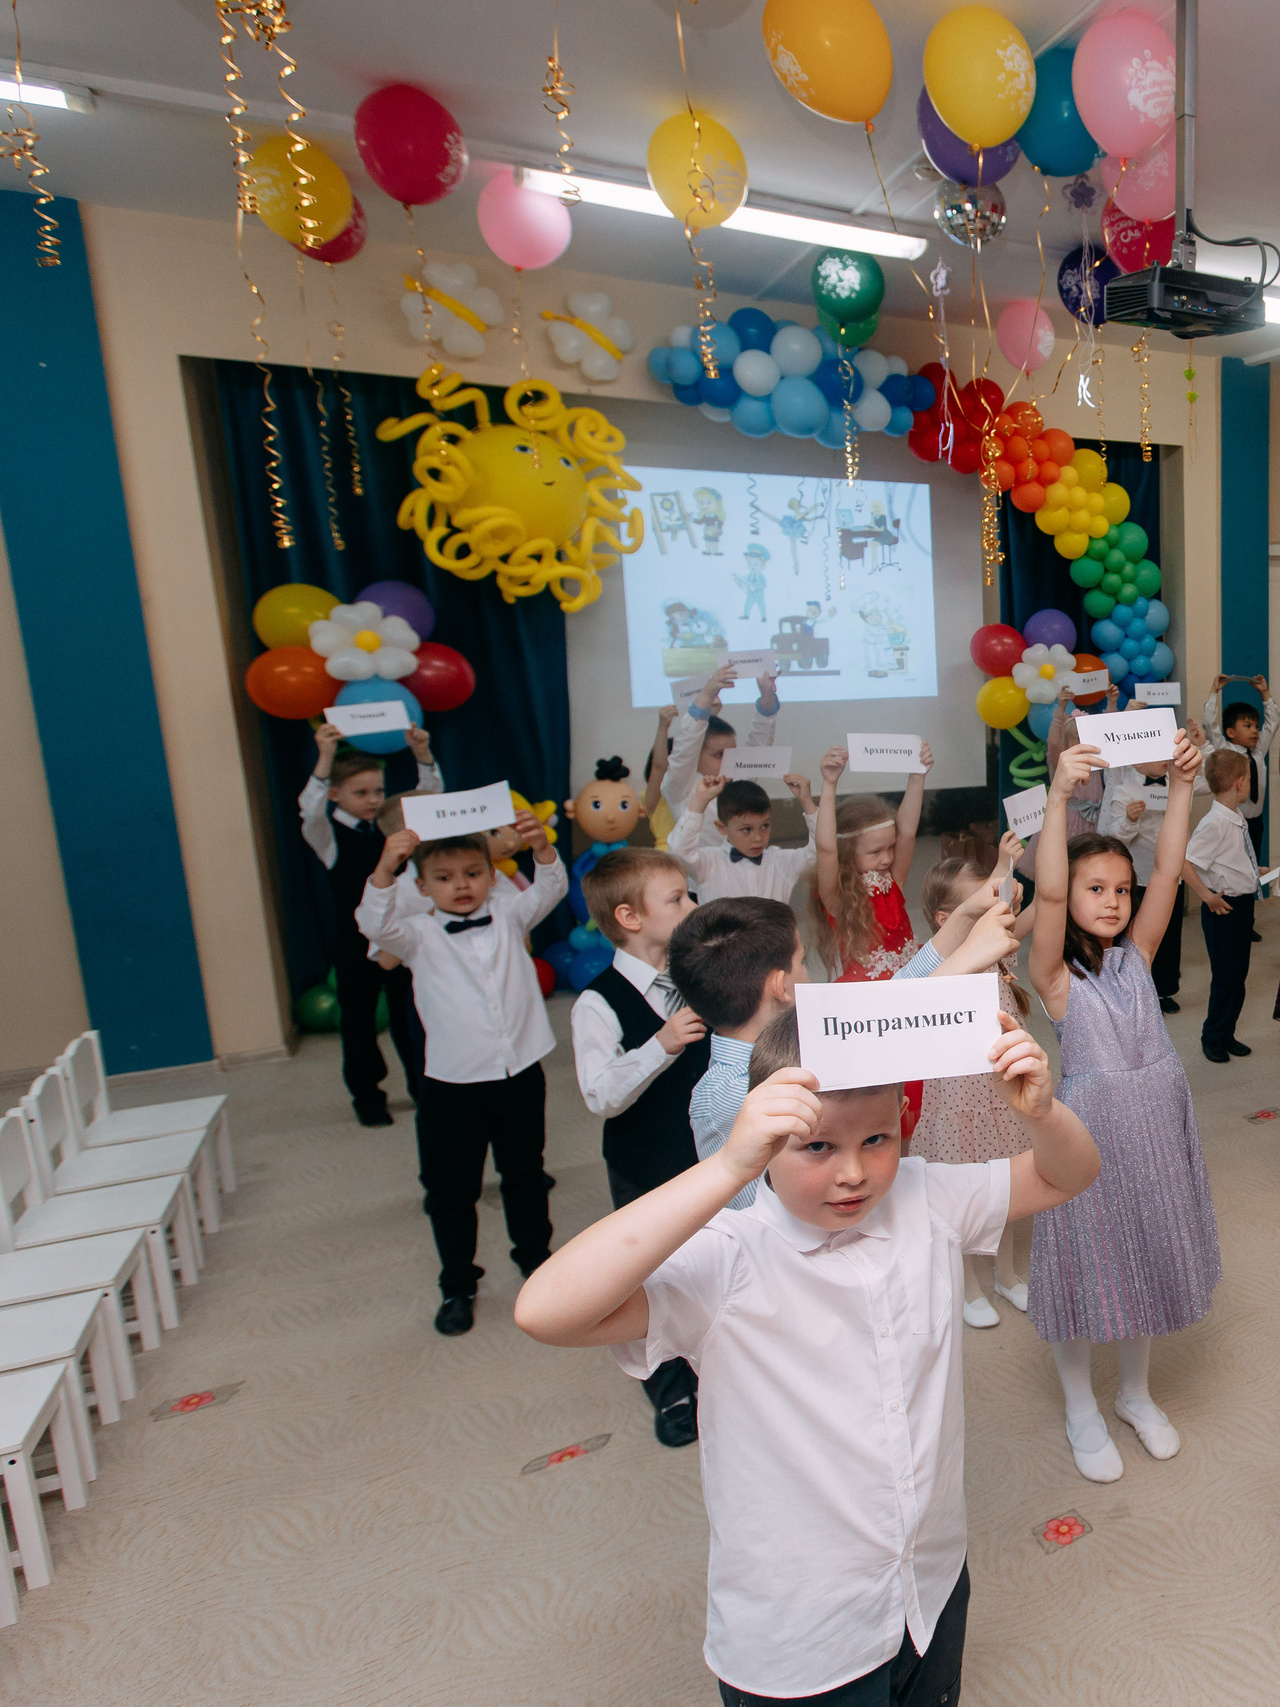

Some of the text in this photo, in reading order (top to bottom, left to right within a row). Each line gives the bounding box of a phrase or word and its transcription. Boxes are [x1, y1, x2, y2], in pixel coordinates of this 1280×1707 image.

[1104, 729, 1163, 745] Музыкант
[862, 746, 913, 757] Архитектор
[435, 804, 487, 819] Повар
[822, 1010, 977, 1041] Программист
